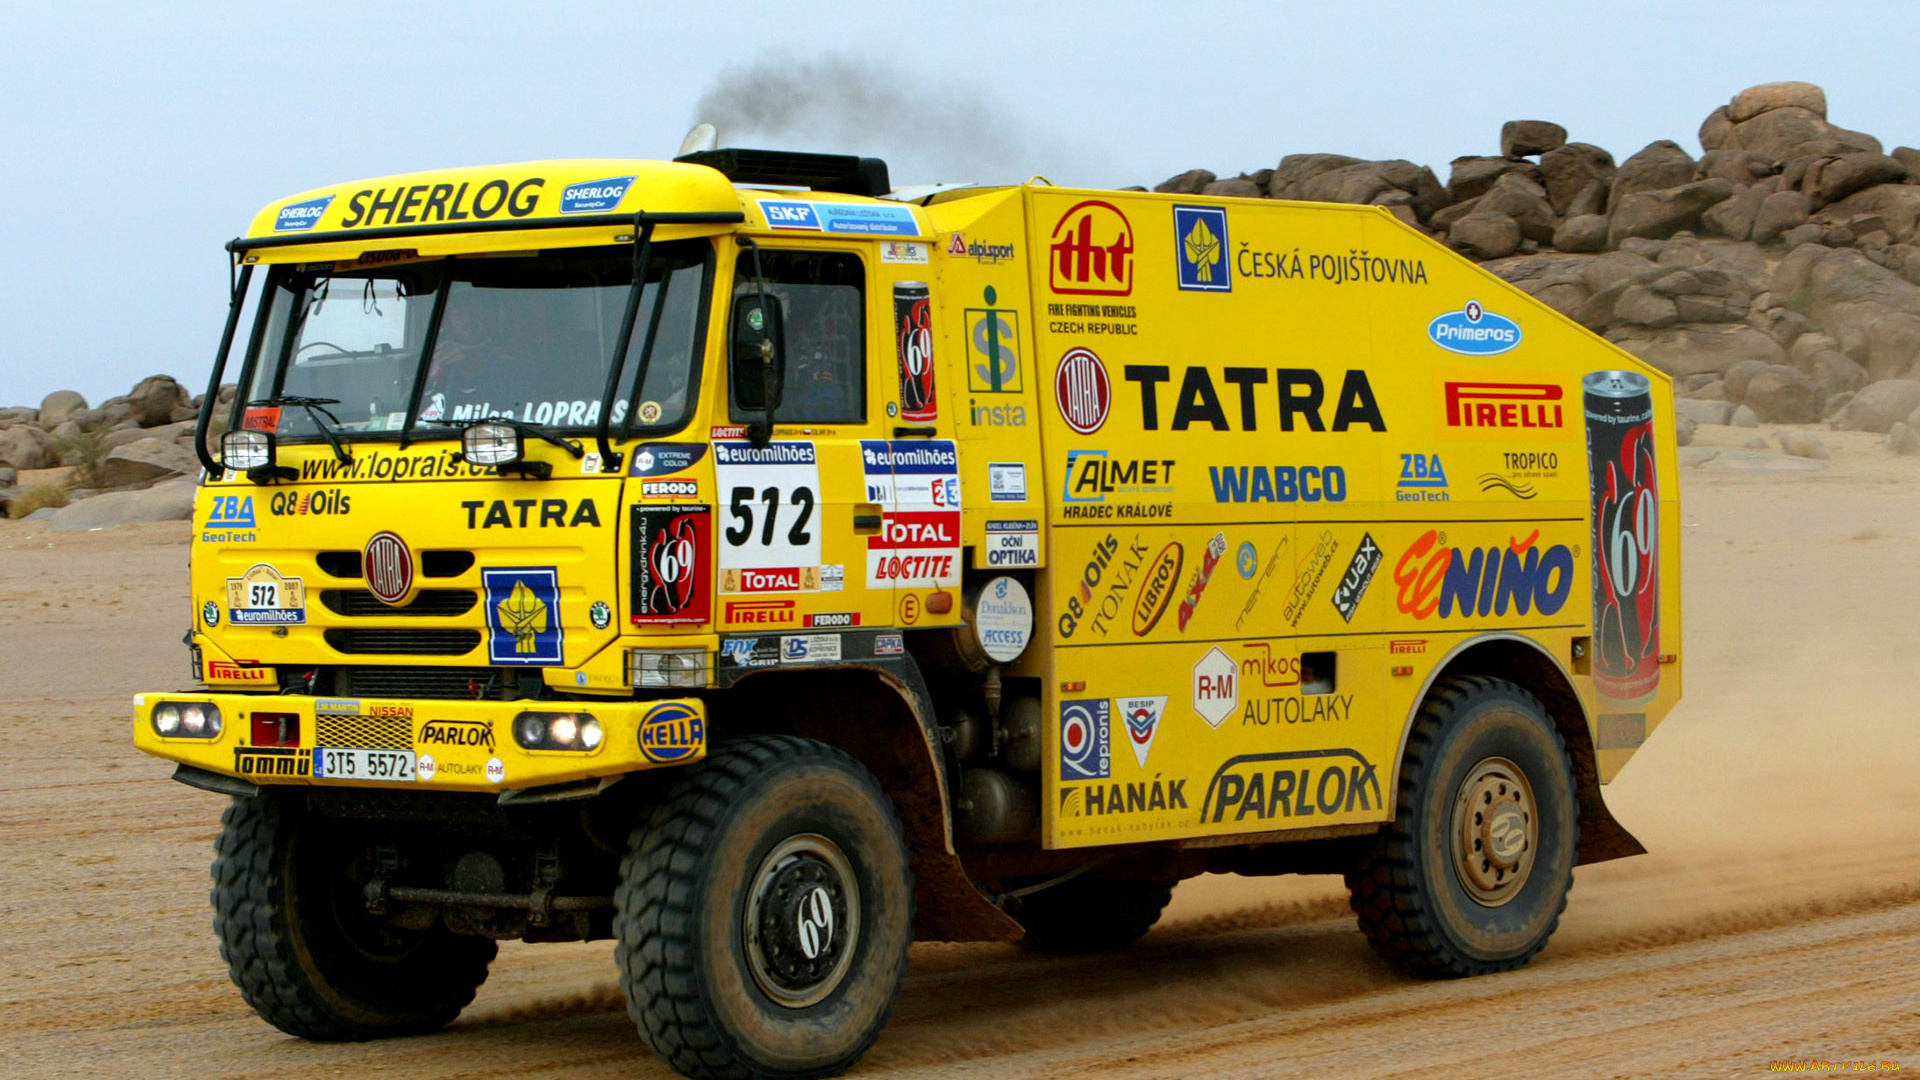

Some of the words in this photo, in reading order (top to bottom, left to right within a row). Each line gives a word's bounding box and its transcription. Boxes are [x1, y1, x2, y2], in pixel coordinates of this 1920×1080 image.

[341, 178, 546, 229] SHERLOG
[565, 186, 624, 200] SHERLOG
[279, 206, 323, 220] SHERLOG
[768, 206, 810, 221] SKF
[1238, 241, 1303, 280] ČESKÁ
[1311, 250, 1428, 285] POJIŠŤOVNA
[1048, 303, 1064, 316] FIRE
[1065, 304, 1100, 317] FIGHTING
[1101, 305, 1136, 318] VEHICLES
[1050, 322, 1084, 334] CZECH
[1087, 322, 1138, 335] REPUBLIC
[1436, 323, 1515, 343] Primeros
[908, 328, 931, 375] 69
[1064, 355, 1101, 428] TATRA
[1124, 364, 1388, 433] TATRA
[523, 400, 629, 426] LOPRAS
[970, 398, 1026, 426] insta
[1444, 381, 1563, 428] PIRELLI
[245, 415, 276, 429] MISTRAL
[658, 452, 692, 460] EXTREME
[663, 459, 689, 467] COLOR
[730, 445, 815, 462] euromilhões
[877, 448, 956, 466] euromilhões
[1400, 453, 1443, 478] ZBA
[1503, 452, 1558, 469] TROPICO
[642, 482, 697, 495] FERODO
[1074, 460, 1176, 493] ALMET
[1208, 465, 1347, 503] WABCO
[270, 491, 298, 516] Q8
[310, 488, 351, 515] Oils
[934, 486, 945, 504] 2
[1396, 491, 1450, 502] GeoTech
[209, 495, 256, 520] ZBA
[461, 498, 602, 529] TATRA
[725, 486, 815, 547] 512
[1063, 504, 1113, 519] HRADEC
[1116, 501, 1173, 518] KRÁLOVÉ
[202, 532, 256, 543] GeoTech
[881, 519, 952, 543] TOTAL
[1001, 535, 1023, 548] OČNÍ
[1611, 488, 1655, 597] 69
[369, 538, 403, 597] TATRA
[639, 516, 649, 614] energydrink4u
[660, 539, 694, 583] 69
[876, 556, 953, 580] LOCTITE
[988, 549, 1037, 565] OPTIKA
[742, 571, 799, 589] TOTAL
[1058, 596, 1084, 638] Q8
[1084, 533, 1119, 588] Oils
[1090, 533, 1149, 638] TONAK
[1283, 530, 1333, 622] autoweb
[1290, 540, 1340, 628] www.autoweb.cz
[251, 585, 275, 606] 512
[1136, 554, 1175, 623] LIBROS
[243, 609, 298, 621] euromilhões
[725, 600, 795, 624] PIRELLI
[905, 600, 915, 619] E
[981, 600, 1027, 615] Donaldson
[814, 614, 850, 626] FERODO
[983, 629, 1023, 644] ACCESS
[1390, 640, 1429, 654] PIRELLI
[208, 659, 265, 680] PIRELLI
[1242, 643, 1301, 687] mikos
[1199, 674, 1233, 700] R-M
[369, 706, 414, 717] NISSAN
[1128, 700, 1154, 709] BESIP
[1242, 695, 1354, 726] AUTOLAKY
[423, 726, 492, 747] PARLOK
[643, 719, 704, 745] HELLA
[1097, 701, 1111, 776] repronis
[234, 747, 311, 775] Tommü
[326, 752, 356, 774] 3T5
[367, 753, 408, 777] 5572
[438, 763, 484, 774] AUTOLAKY
[1085, 773, 1189, 816] HANÁK
[1212, 765, 1377, 823] PARLOK
[797, 887, 834, 960] 69
